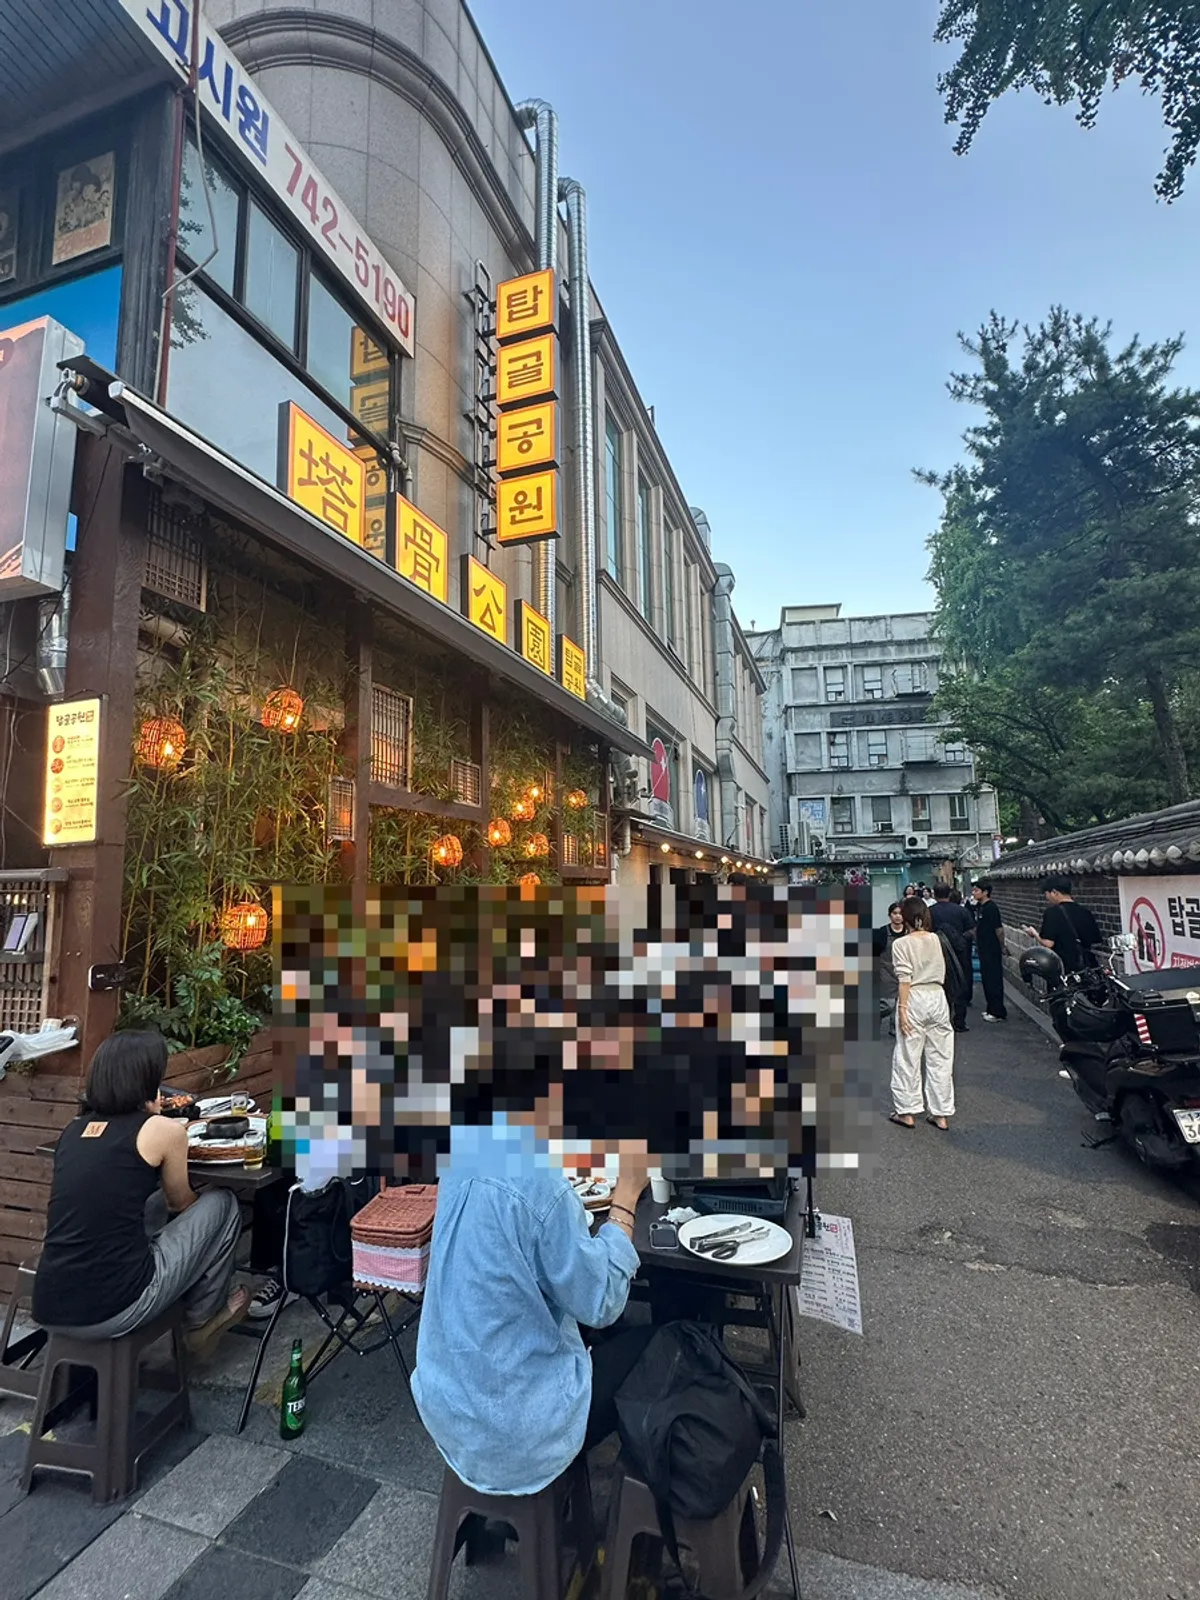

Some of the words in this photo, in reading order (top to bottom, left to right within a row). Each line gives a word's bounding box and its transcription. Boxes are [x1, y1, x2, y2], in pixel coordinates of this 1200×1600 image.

[146, 0, 270, 167] 고시원
[284, 142, 410, 339] 742-5190
[505, 283, 545, 527] 탑골공원
